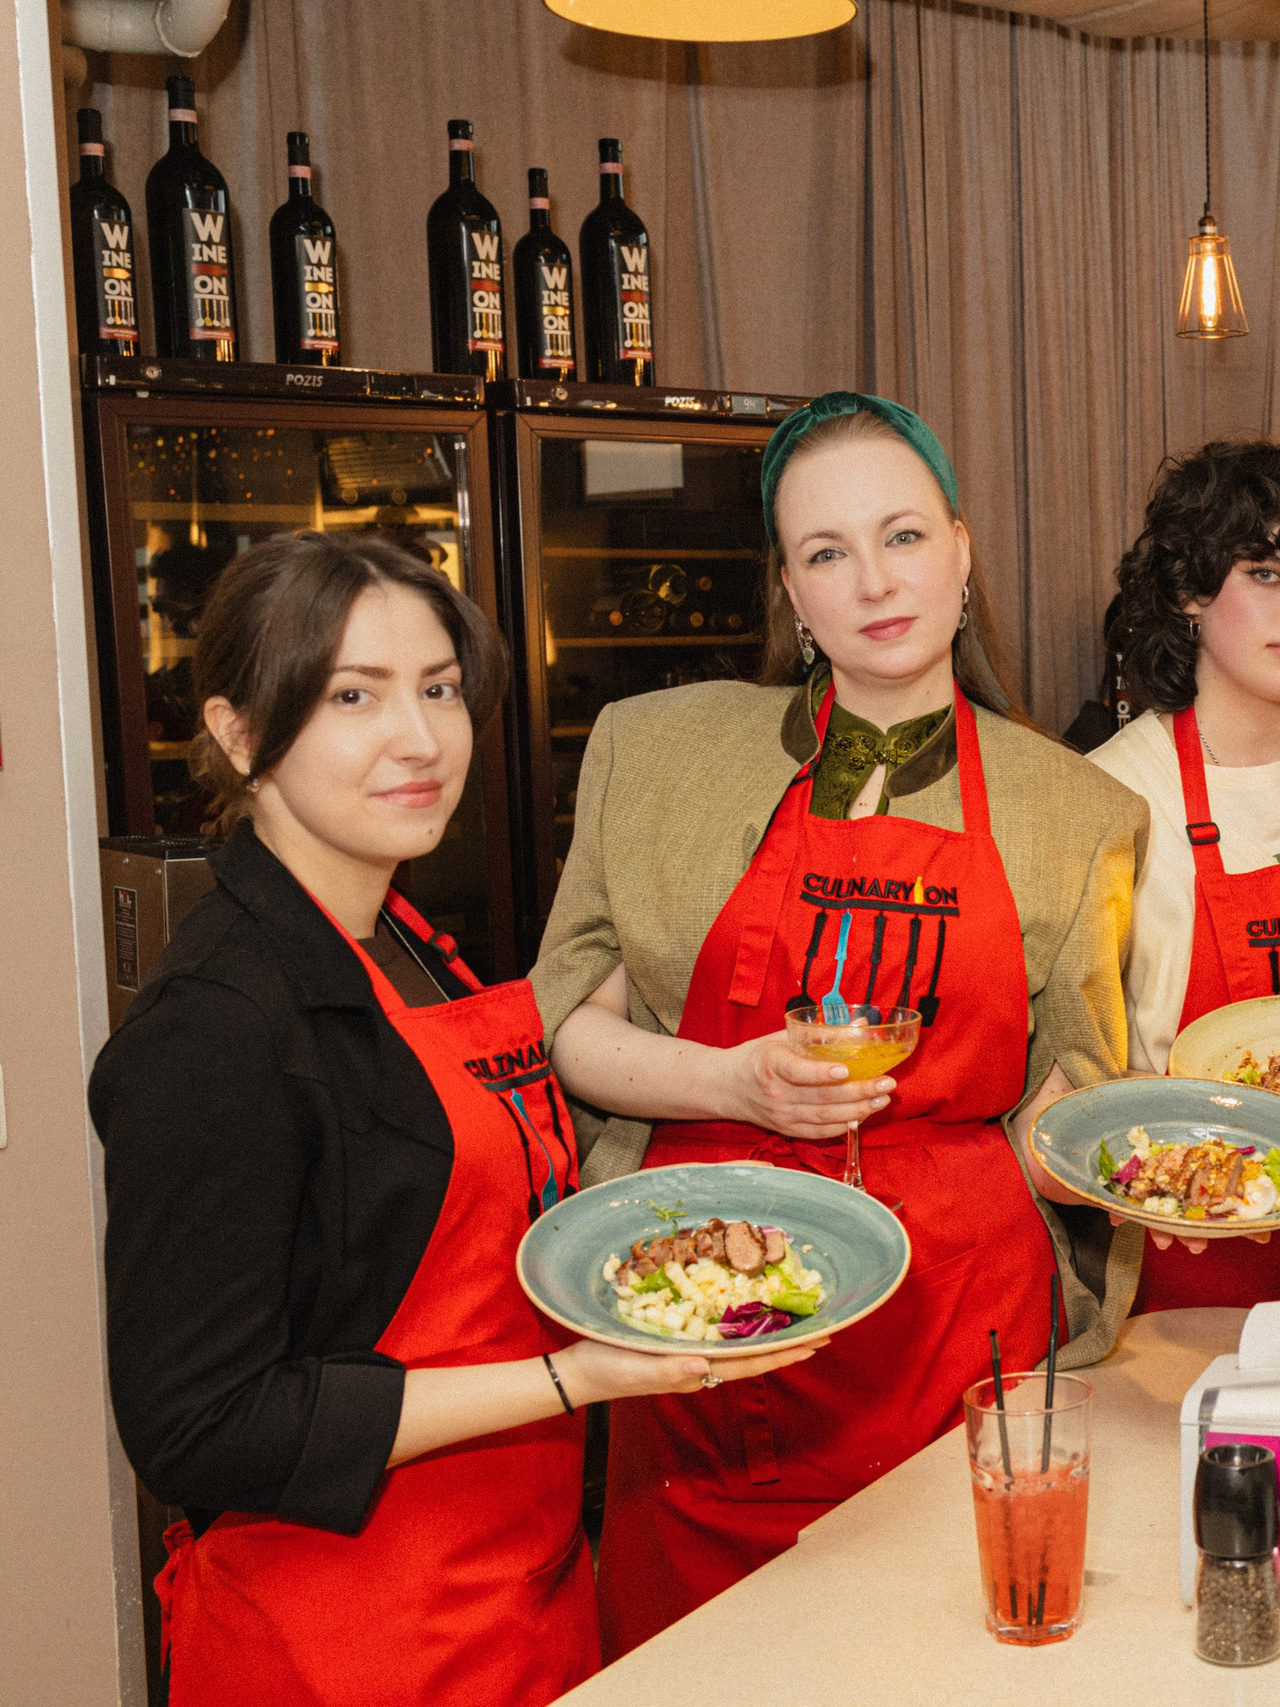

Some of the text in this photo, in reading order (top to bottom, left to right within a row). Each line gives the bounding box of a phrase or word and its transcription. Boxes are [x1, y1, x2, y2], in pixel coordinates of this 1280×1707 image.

[101, 222, 129, 250] W
[190, 212, 224, 243] W
[191, 243, 227, 264] INE
[303, 238, 331, 265] W
[471, 232, 499, 261] W
[102, 250, 132, 269] INE
[620, 245, 647, 273] W
[304, 265, 334, 283] INE
[472, 261, 500, 281] INE
[541, 265, 567, 290] W
[104, 278, 132, 296] ON
[193, 275, 227, 296] ON
[621, 273, 649, 291] INE
[305, 292, 333, 309] ON
[473, 290, 500, 309] ON
[542, 290, 569, 306] INE
[623, 301, 649, 318] ON
[543, 315, 568, 330] ON
[285, 373, 324, 387] POZIS
